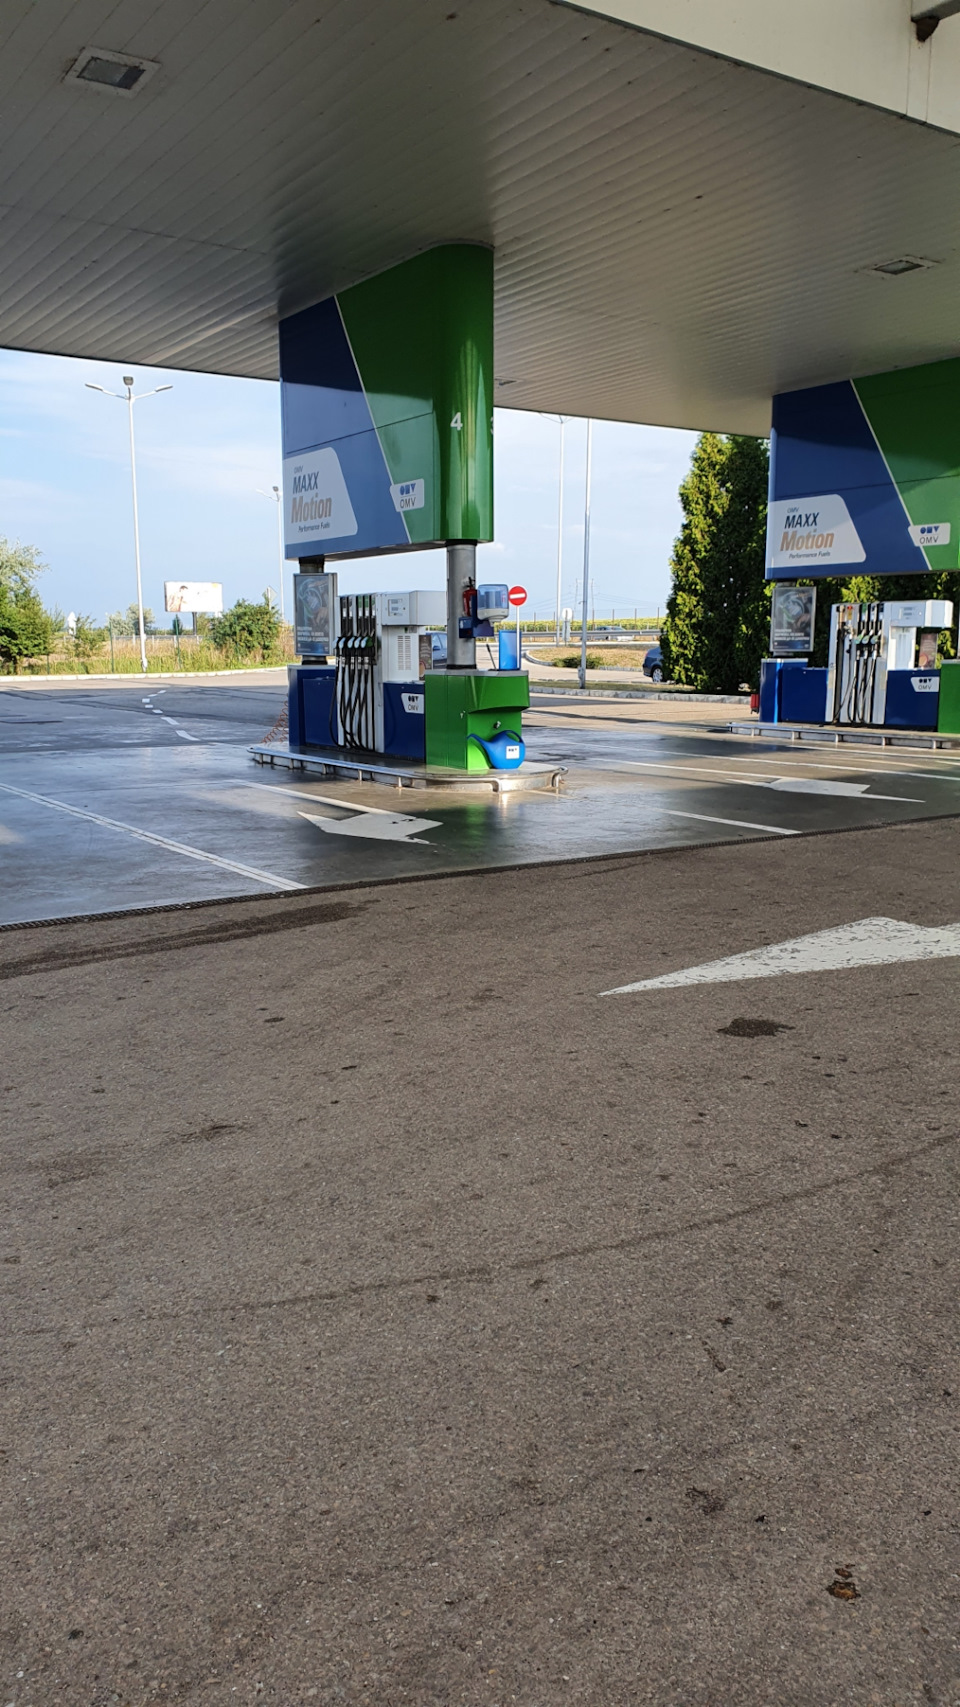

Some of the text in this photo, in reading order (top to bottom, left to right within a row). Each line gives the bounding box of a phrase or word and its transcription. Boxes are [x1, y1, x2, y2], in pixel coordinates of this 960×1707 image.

[450, 412, 463, 431] 4
[293, 471, 319, 494] MAXX
[291, 492, 332, 523] Motion
[400, 497, 416, 509] OMV
[784, 511, 819, 529] MAXX
[780, 528, 834, 552] Motion
[919, 535, 939, 545] OMV
[788, 550, 831, 560] Performance Fuels
